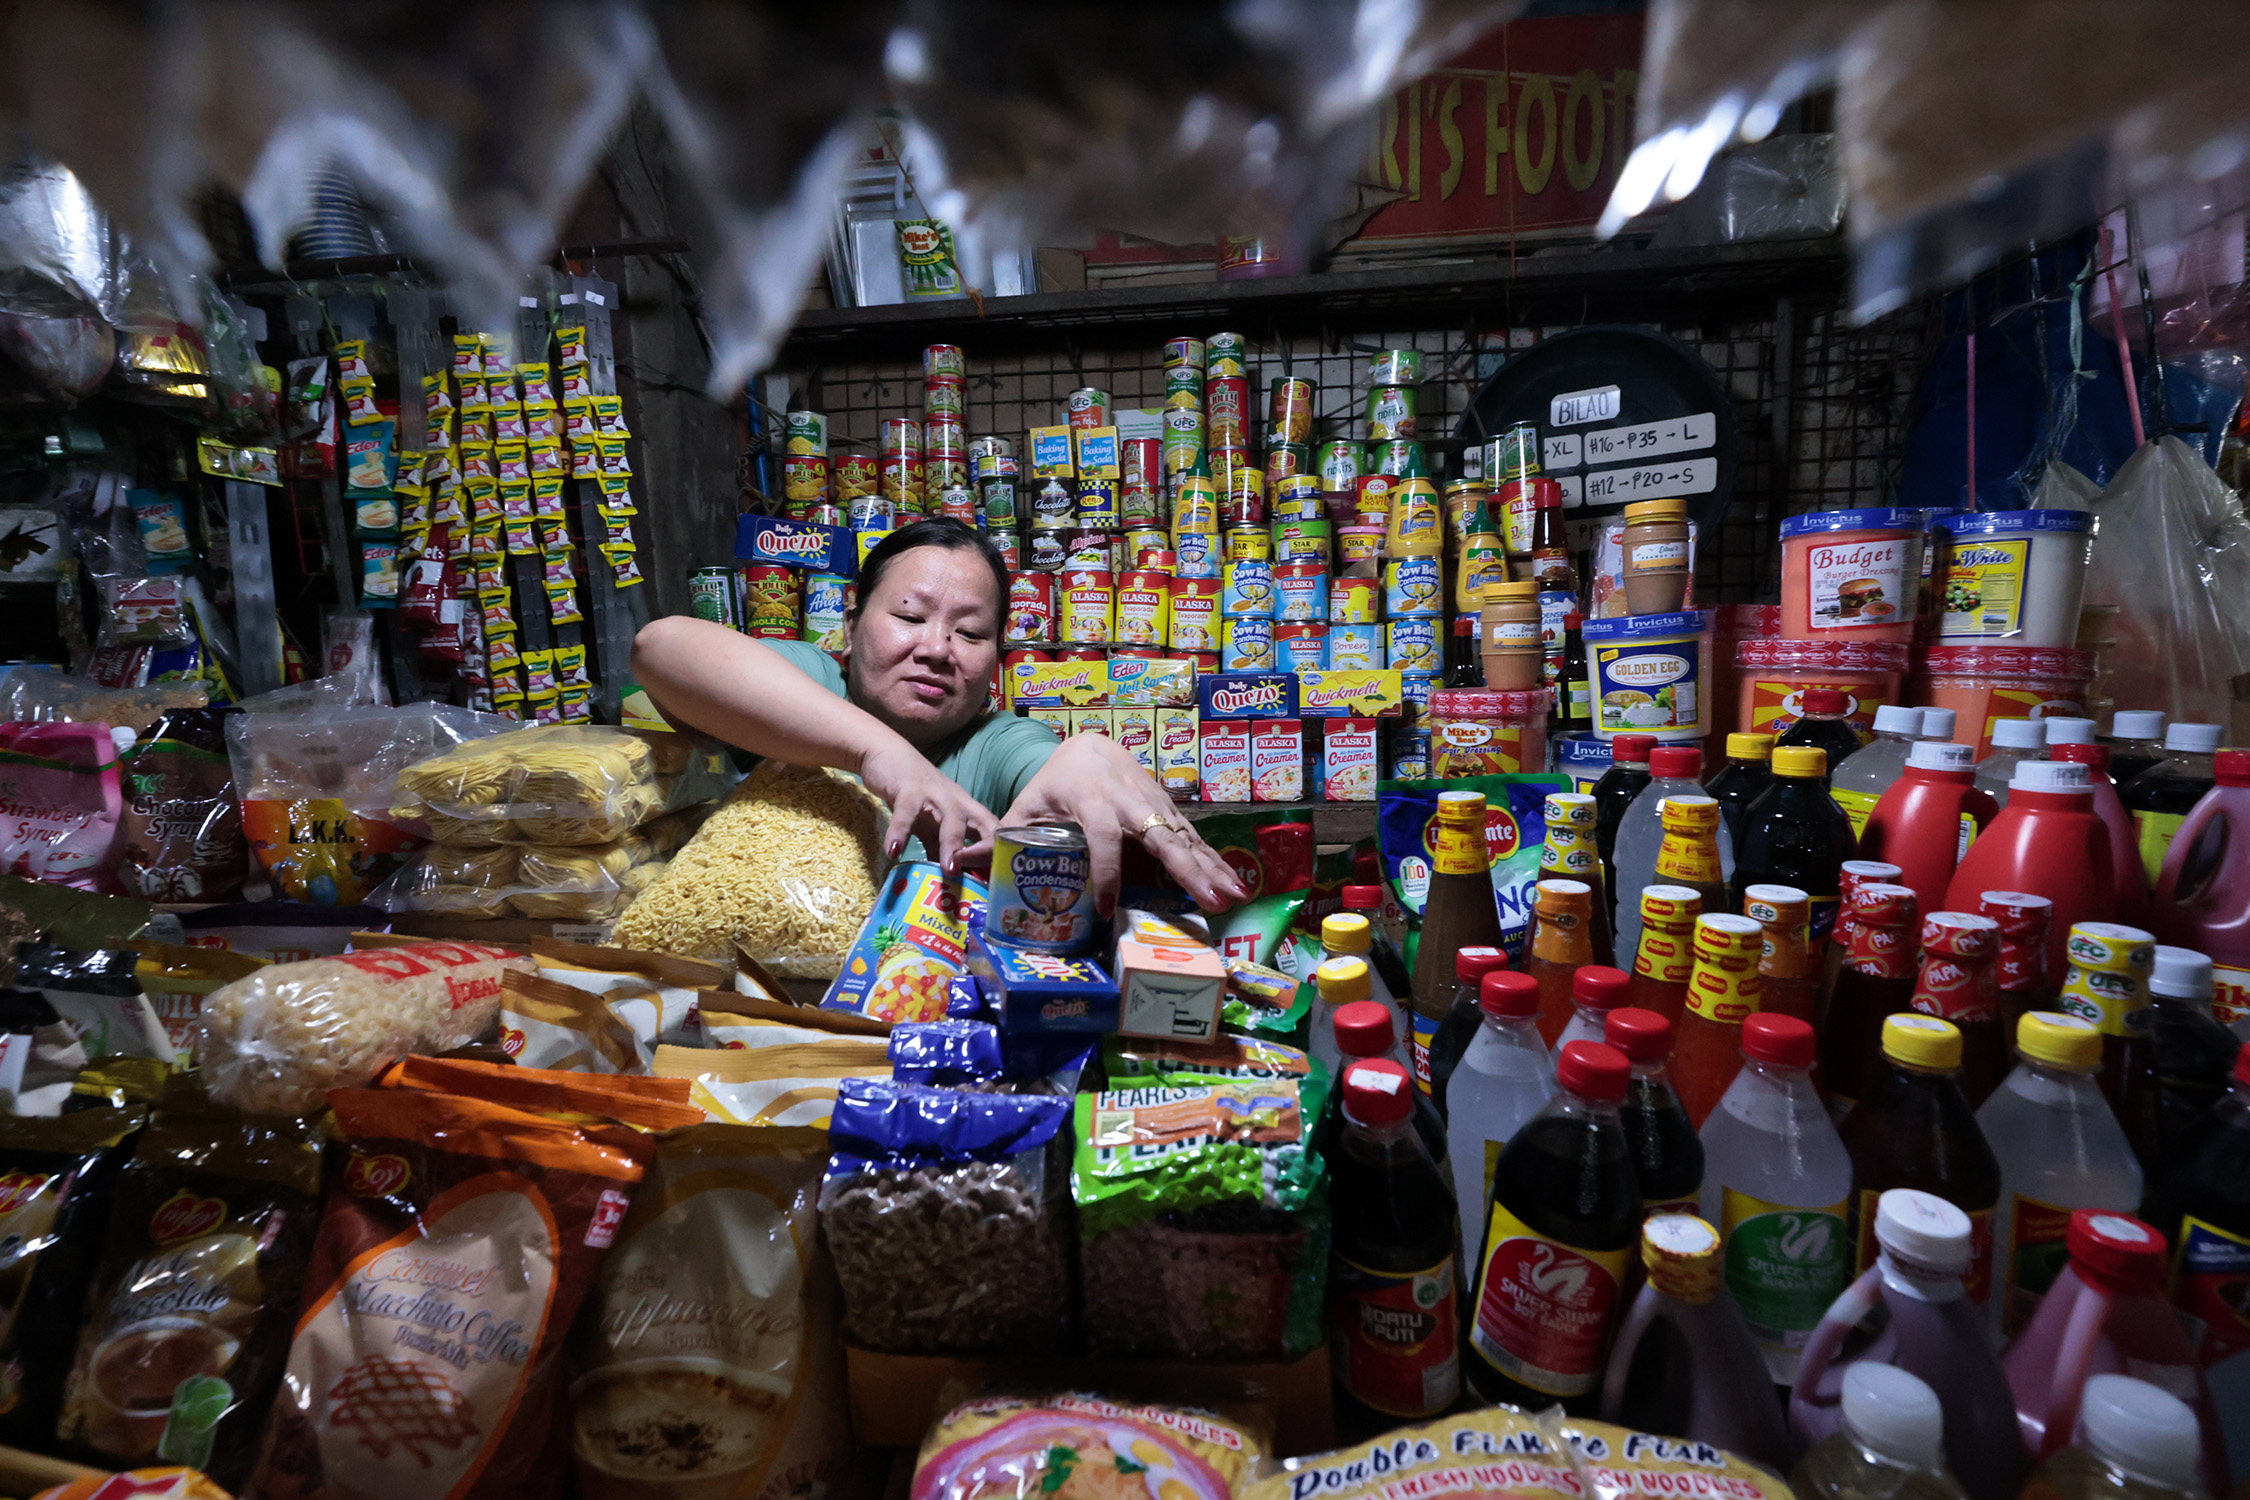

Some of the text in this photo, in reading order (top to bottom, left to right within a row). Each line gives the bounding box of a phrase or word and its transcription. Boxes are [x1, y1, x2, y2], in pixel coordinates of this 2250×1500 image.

[903, 230, 938, 244] Mike's
[1070, 398, 1090, 408] UFC
[1558, 392, 1610, 425] BILAO
[1174, 419, 1195, 427] UFC
[347, 438, 382, 456] Eden
[1590, 436, 1614, 455] #16
[1684, 424, 1699, 441] L
[1037, 444, 1065, 456] Baking
[1084, 446, 1113, 458] Baking
[1552, 441, 1574, 459] XL
[1046, 453, 1067, 464] Soda
[1092, 453, 1113, 464] Soda
[1590, 475, 1616, 497] #12
[1682, 467, 1694, 484] S
[947, 495, 966, 503] UFC
[1034, 497, 1072, 511] Chocolate
[1079, 496, 1103, 506] Reno
[135, 502, 175, 521] Eden
[1400, 517, 1435, 536] Mustard
[1802, 511, 1863, 530] Invictus
[1958, 514, 2023, 532] Invictus
[775, 523, 794, 535] Daily
[757, 530, 822, 556] Quezo
[1069, 533, 1107, 550] Alpine
[1293, 540, 1311, 548] STAR
[1347, 539, 1365, 547] STAR
[362, 547, 398, 561] Eden
[1031, 551, 1066, 565] Chocolate
[1814, 547, 1893, 570] Budget
[1961, 549, 2014, 568] White
[1232, 564, 1273, 581] Cow Bell
[1396, 564, 1441, 581] Cow Bell
[1823, 566, 1900, 582] Burger Dressing
[1282, 580, 1314, 589] ALASKA
[809, 595, 842, 613] Ange
[1071, 592, 1109, 602] ALASKA
[1121, 592, 1158, 604] ALASKA
[1010, 600, 1047, 612] aporada
[1075, 603, 1106, 612] Evaporada
[1123, 605, 1154, 613] Evaporada
[1174, 600, 1212, 611] ALASKA
[1069, 616, 1077, 628] 1
[1177, 612, 1209, 620] Evaporada
[1627, 611, 1685, 630] Invictus
[1231, 624, 1272, 638] Cow Bell
[1391, 623, 1436, 639] Cow Bell
[1289, 640, 1322, 650] ALASKA
[1334, 639, 1369, 651] Doreen
[1112, 661, 1144, 679] Eden
[1615, 660, 1680, 676] GOLDEN EGG
[1020, 670, 1088, 696] Quickmelt!
[1116, 680, 1140, 697] Melt
[1229, 681, 1248, 691] Daily
[1212, 687, 1279, 712] Quezo
[1306, 679, 1380, 706] Quickmelt!
[1448, 727, 1486, 737] Mike's
[1118, 733, 1148, 749] Cream
[1161, 732, 1191, 750] Cream
[1206, 739, 1243, 749] ALASKA
[1258, 738, 1296, 748] ALASKA
[1331, 737, 1369, 747] ALASKA
[1464, 745, 1502, 755] Dressing
[1204, 753, 1247, 768] Creamer
[1255, 753, 1300, 768] Creamer
[1328, 752, 1374, 766] Creamer
[1572, 809, 1594, 821] UFC
[1552, 828, 1575, 840] UFC
[1012, 854, 1090, 877] Cow Bell
[1567, 853, 1593, 865] UFC
[1403, 865, 1425, 881] 100
[1014, 874, 1086, 891] Condensada
[1750, 906, 1774, 918] UFC
[918, 913, 962, 939] Mixed
[919, 933, 934, 947] #1
[2069, 938, 2106, 958] UFC
[1927, 963, 1965, 985] PAPA
[2089, 972, 2137, 993] UFC
[444, 976, 501, 1010] IDEAL
[2062, 998, 2098, 1019] UFC
[1096, 1085, 1188, 1108] PEARLS
[362, 1248, 497, 1297] Caramel
[353, 1280, 532, 1366] Macchiato Coffee
[1373, 1309, 1424, 1328] DATU
[1374, 1324, 1415, 1342] PUTI
[1291, 1438, 1440, 1500] Double
[1638, 1472, 1763, 1498] NOODLES
